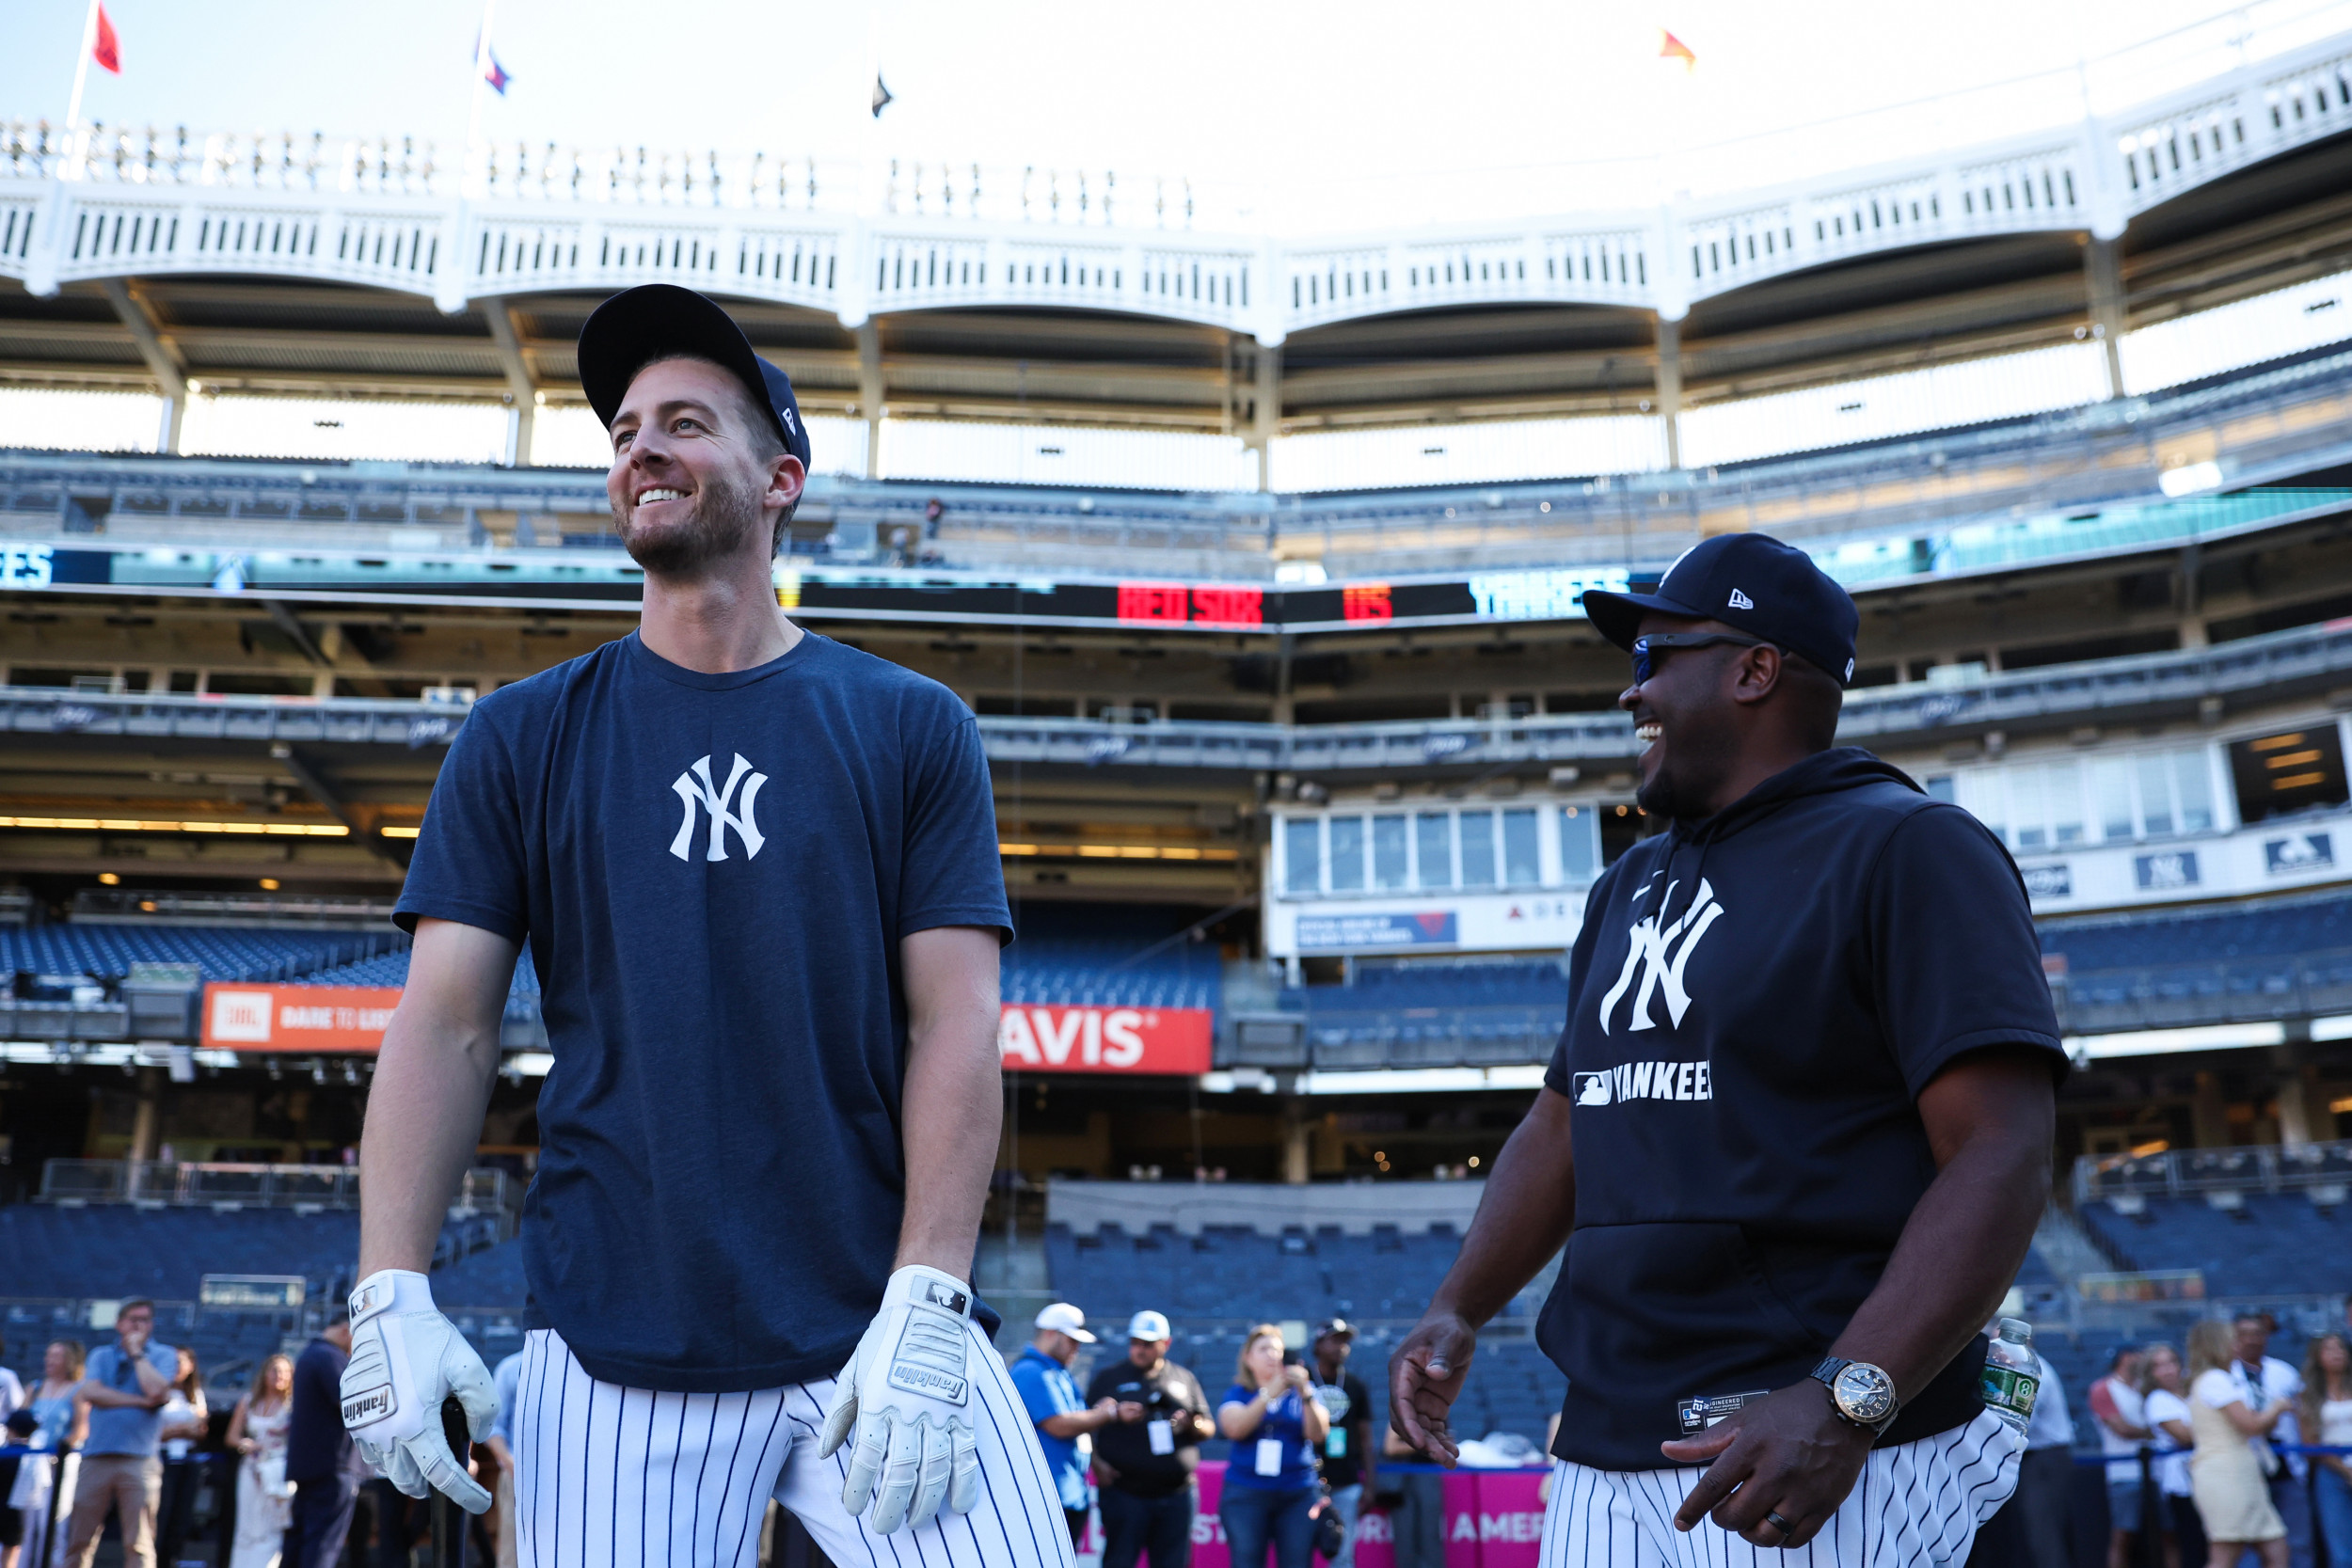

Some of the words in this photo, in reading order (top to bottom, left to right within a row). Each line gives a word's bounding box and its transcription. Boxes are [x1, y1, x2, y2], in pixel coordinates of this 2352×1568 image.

[1118, 581, 1187, 627] RED
[1192, 583, 1263, 630] SOX
[669, 752, 769, 863] NY
[1599, 877, 1724, 1036] NY
[279, 1006, 333, 1030] DARE
[336, 1007, 357, 1030] TO
[998, 1007, 1144, 1068] AVIS
[1613, 1060, 1712, 1104] YANKEE
